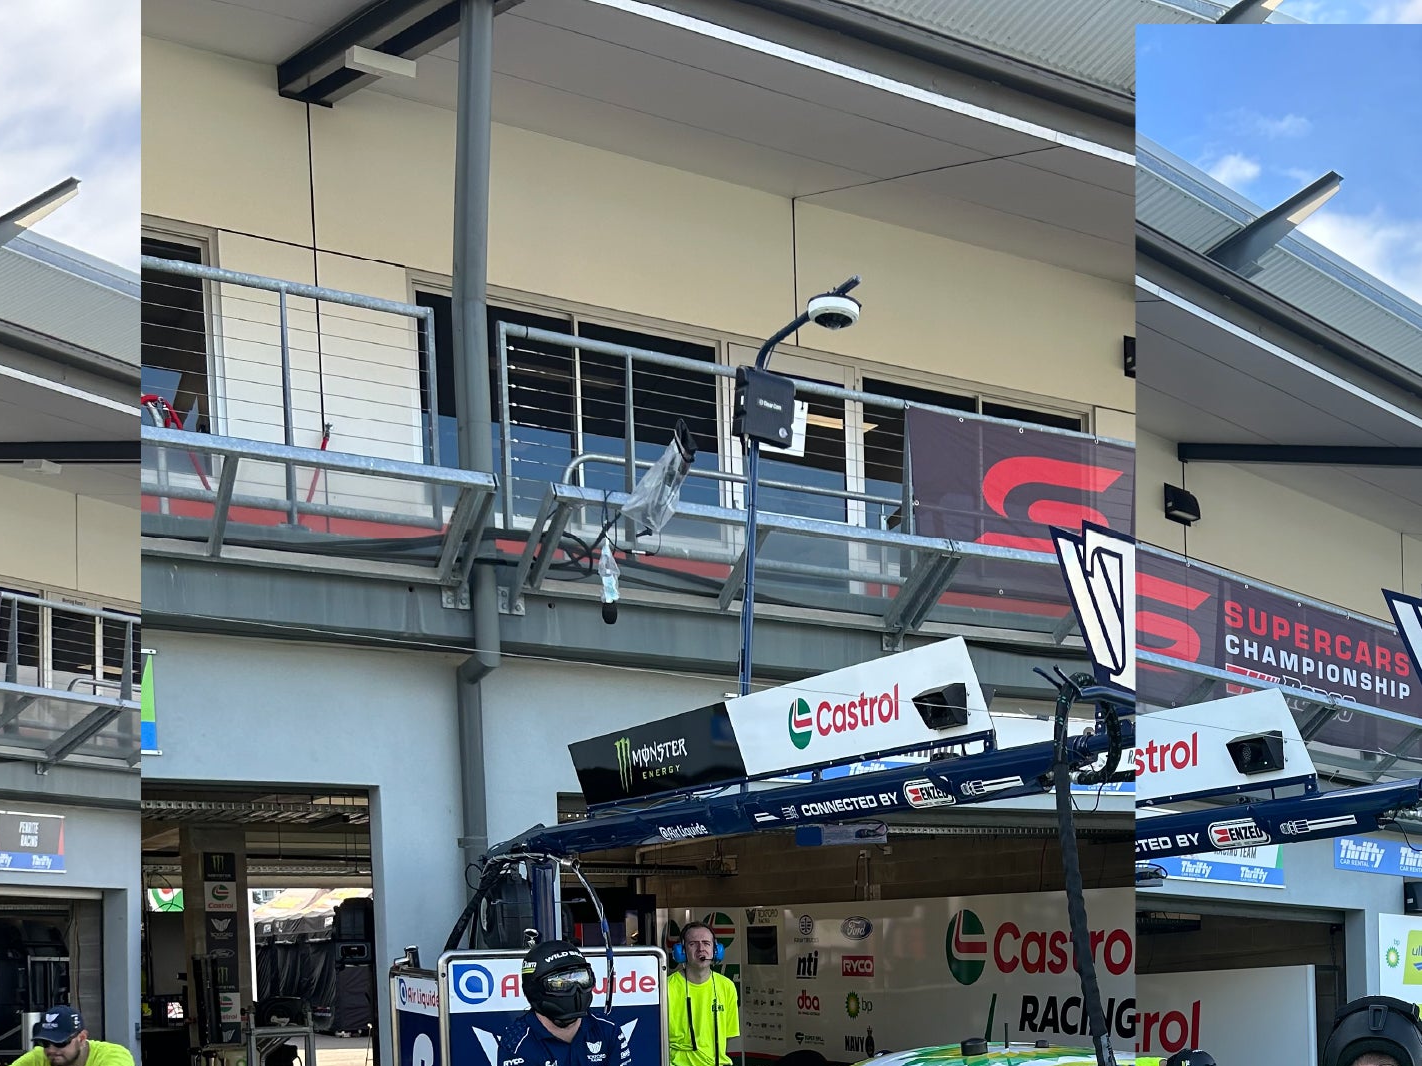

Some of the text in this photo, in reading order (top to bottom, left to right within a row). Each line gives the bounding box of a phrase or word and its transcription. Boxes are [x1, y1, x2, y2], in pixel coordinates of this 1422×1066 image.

[1224, 598, 1411, 678] SUPERCARS
[1225, 633, 1412, 700] CHAMPIONSHIP
[816, 683, 900, 738] Castrol
[631, 737, 688, 769] MONSTER
[642, 764, 681, 780] ENERGY
[801, 790, 899, 818] CONNECTED BY
[1179, 832, 1200, 849] BY
[1339, 839, 1385, 868] Thrifty
[1181, 860, 1213, 880] Thrifty
[1353, 860, 1370, 868] RENTAL
[1240, 866, 1269, 884] Thrifty
[544, 951, 565, 964] WILD
[796, 950, 819, 977] nti
[843, 959, 874, 973] RYCO
[797, 989, 820, 1011] dba
[861, 997, 873, 1012] bp
[845, 1035, 865, 1053] NAVY
[503, 1057, 525, 1066] RYCO
